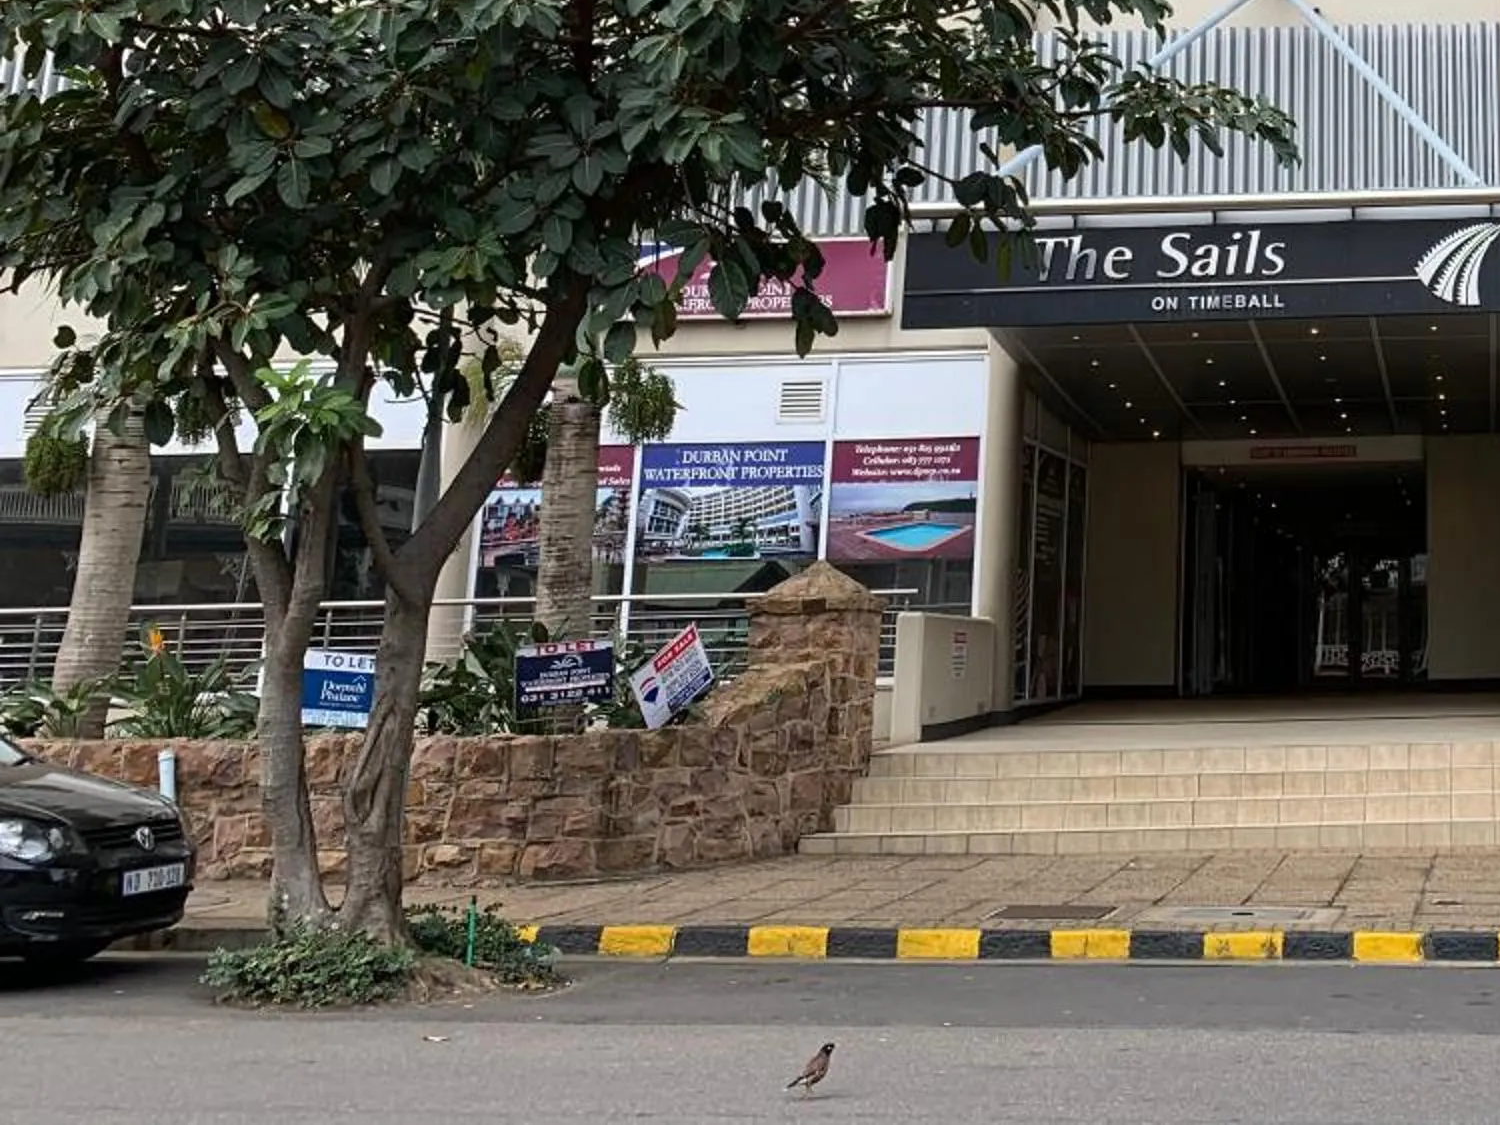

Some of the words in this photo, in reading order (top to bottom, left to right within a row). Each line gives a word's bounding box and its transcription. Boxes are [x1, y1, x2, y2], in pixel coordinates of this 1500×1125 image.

[1034, 234, 1133, 282] The
[1156, 229, 1286, 279] Sails
[1151, 296, 1178, 311] ON
[1188, 294, 1285, 310] TIMEBALL
[682, 449, 740, 465] DURBAN
[744, 448, 788, 462] POINT
[644, 466, 738, 481] WATERFRONT
[741, 465, 824, 479] PROPERTIES
[536, 642, 558, 657] TO
[565, 640, 595, 653] LET
[324, 654, 344, 667] TO
[349, 656, 376, 670] LET
